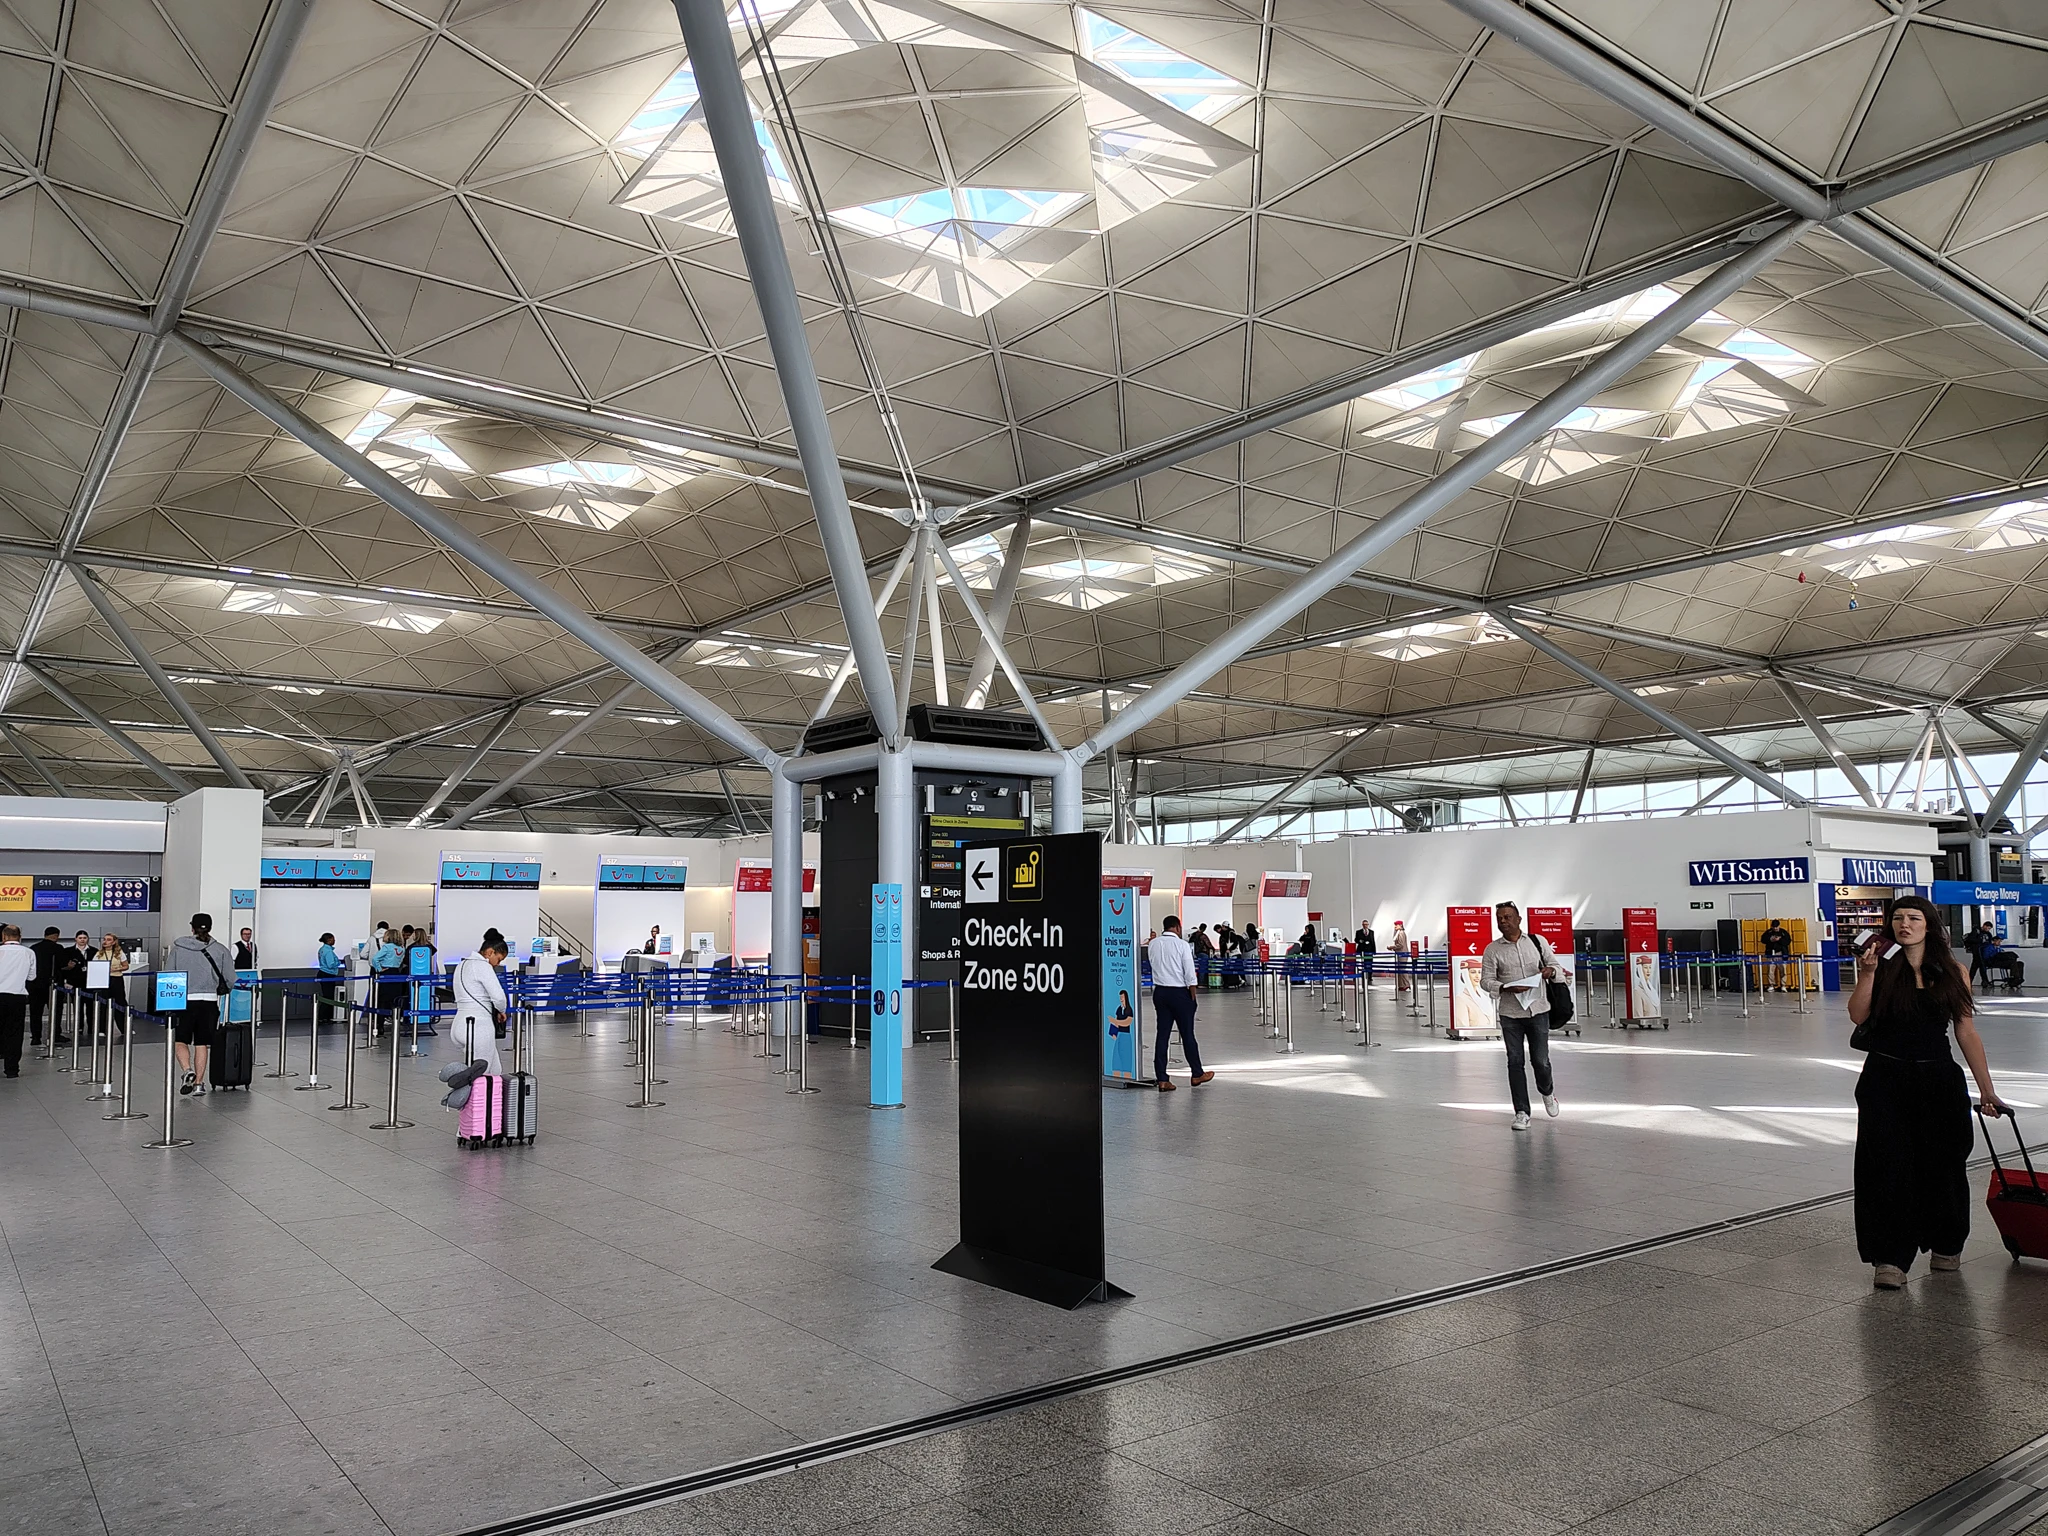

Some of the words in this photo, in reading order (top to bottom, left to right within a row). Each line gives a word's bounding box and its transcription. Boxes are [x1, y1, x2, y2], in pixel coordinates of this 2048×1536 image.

[1692, 860, 1804, 883] WHSmith
[1852, 860, 1913, 884] WHSmith
[1975, 887, 1999, 902] Change
[2000, 888, 2019, 902] Money
[965, 918, 1063, 947] Check-In
[1110, 925, 1126, 934] Head
[1105, 937, 1118, 946] this
[1119, 940, 1131, 948] way
[922, 950, 945, 960] Shops
[947, 950, 953, 958] &
[1107, 948, 1117, 957] for
[1119, 949, 1129, 957] TUI
[964, 961, 1017, 991] Zone
[1023, 963, 1064, 993] 500
